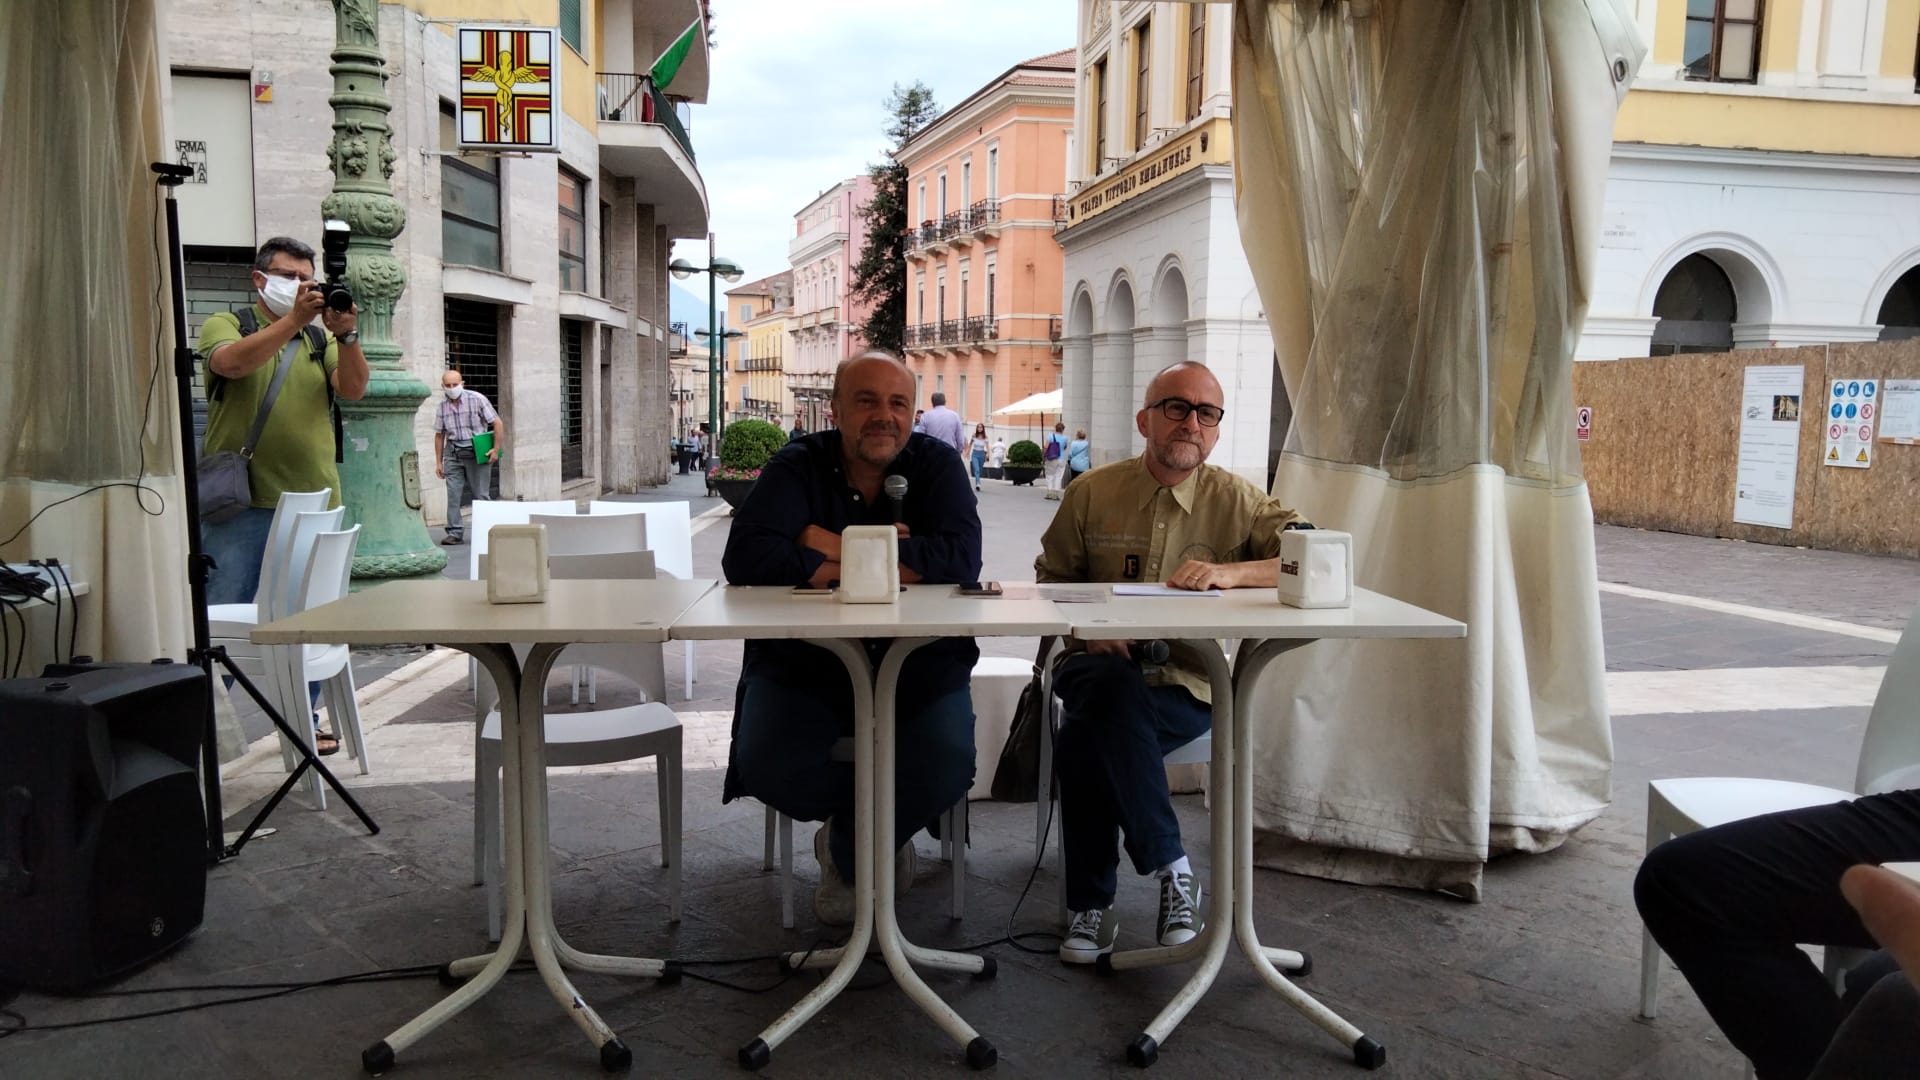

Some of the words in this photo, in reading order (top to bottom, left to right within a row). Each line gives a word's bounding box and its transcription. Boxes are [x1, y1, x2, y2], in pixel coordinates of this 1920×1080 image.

[263, 72, 270, 82] 2
[1081, 194, 1102, 215] TEATRO
[1105, 176, 1136, 202] VITTORIO
[1139, 146, 1191, 185] EMMANUELE
